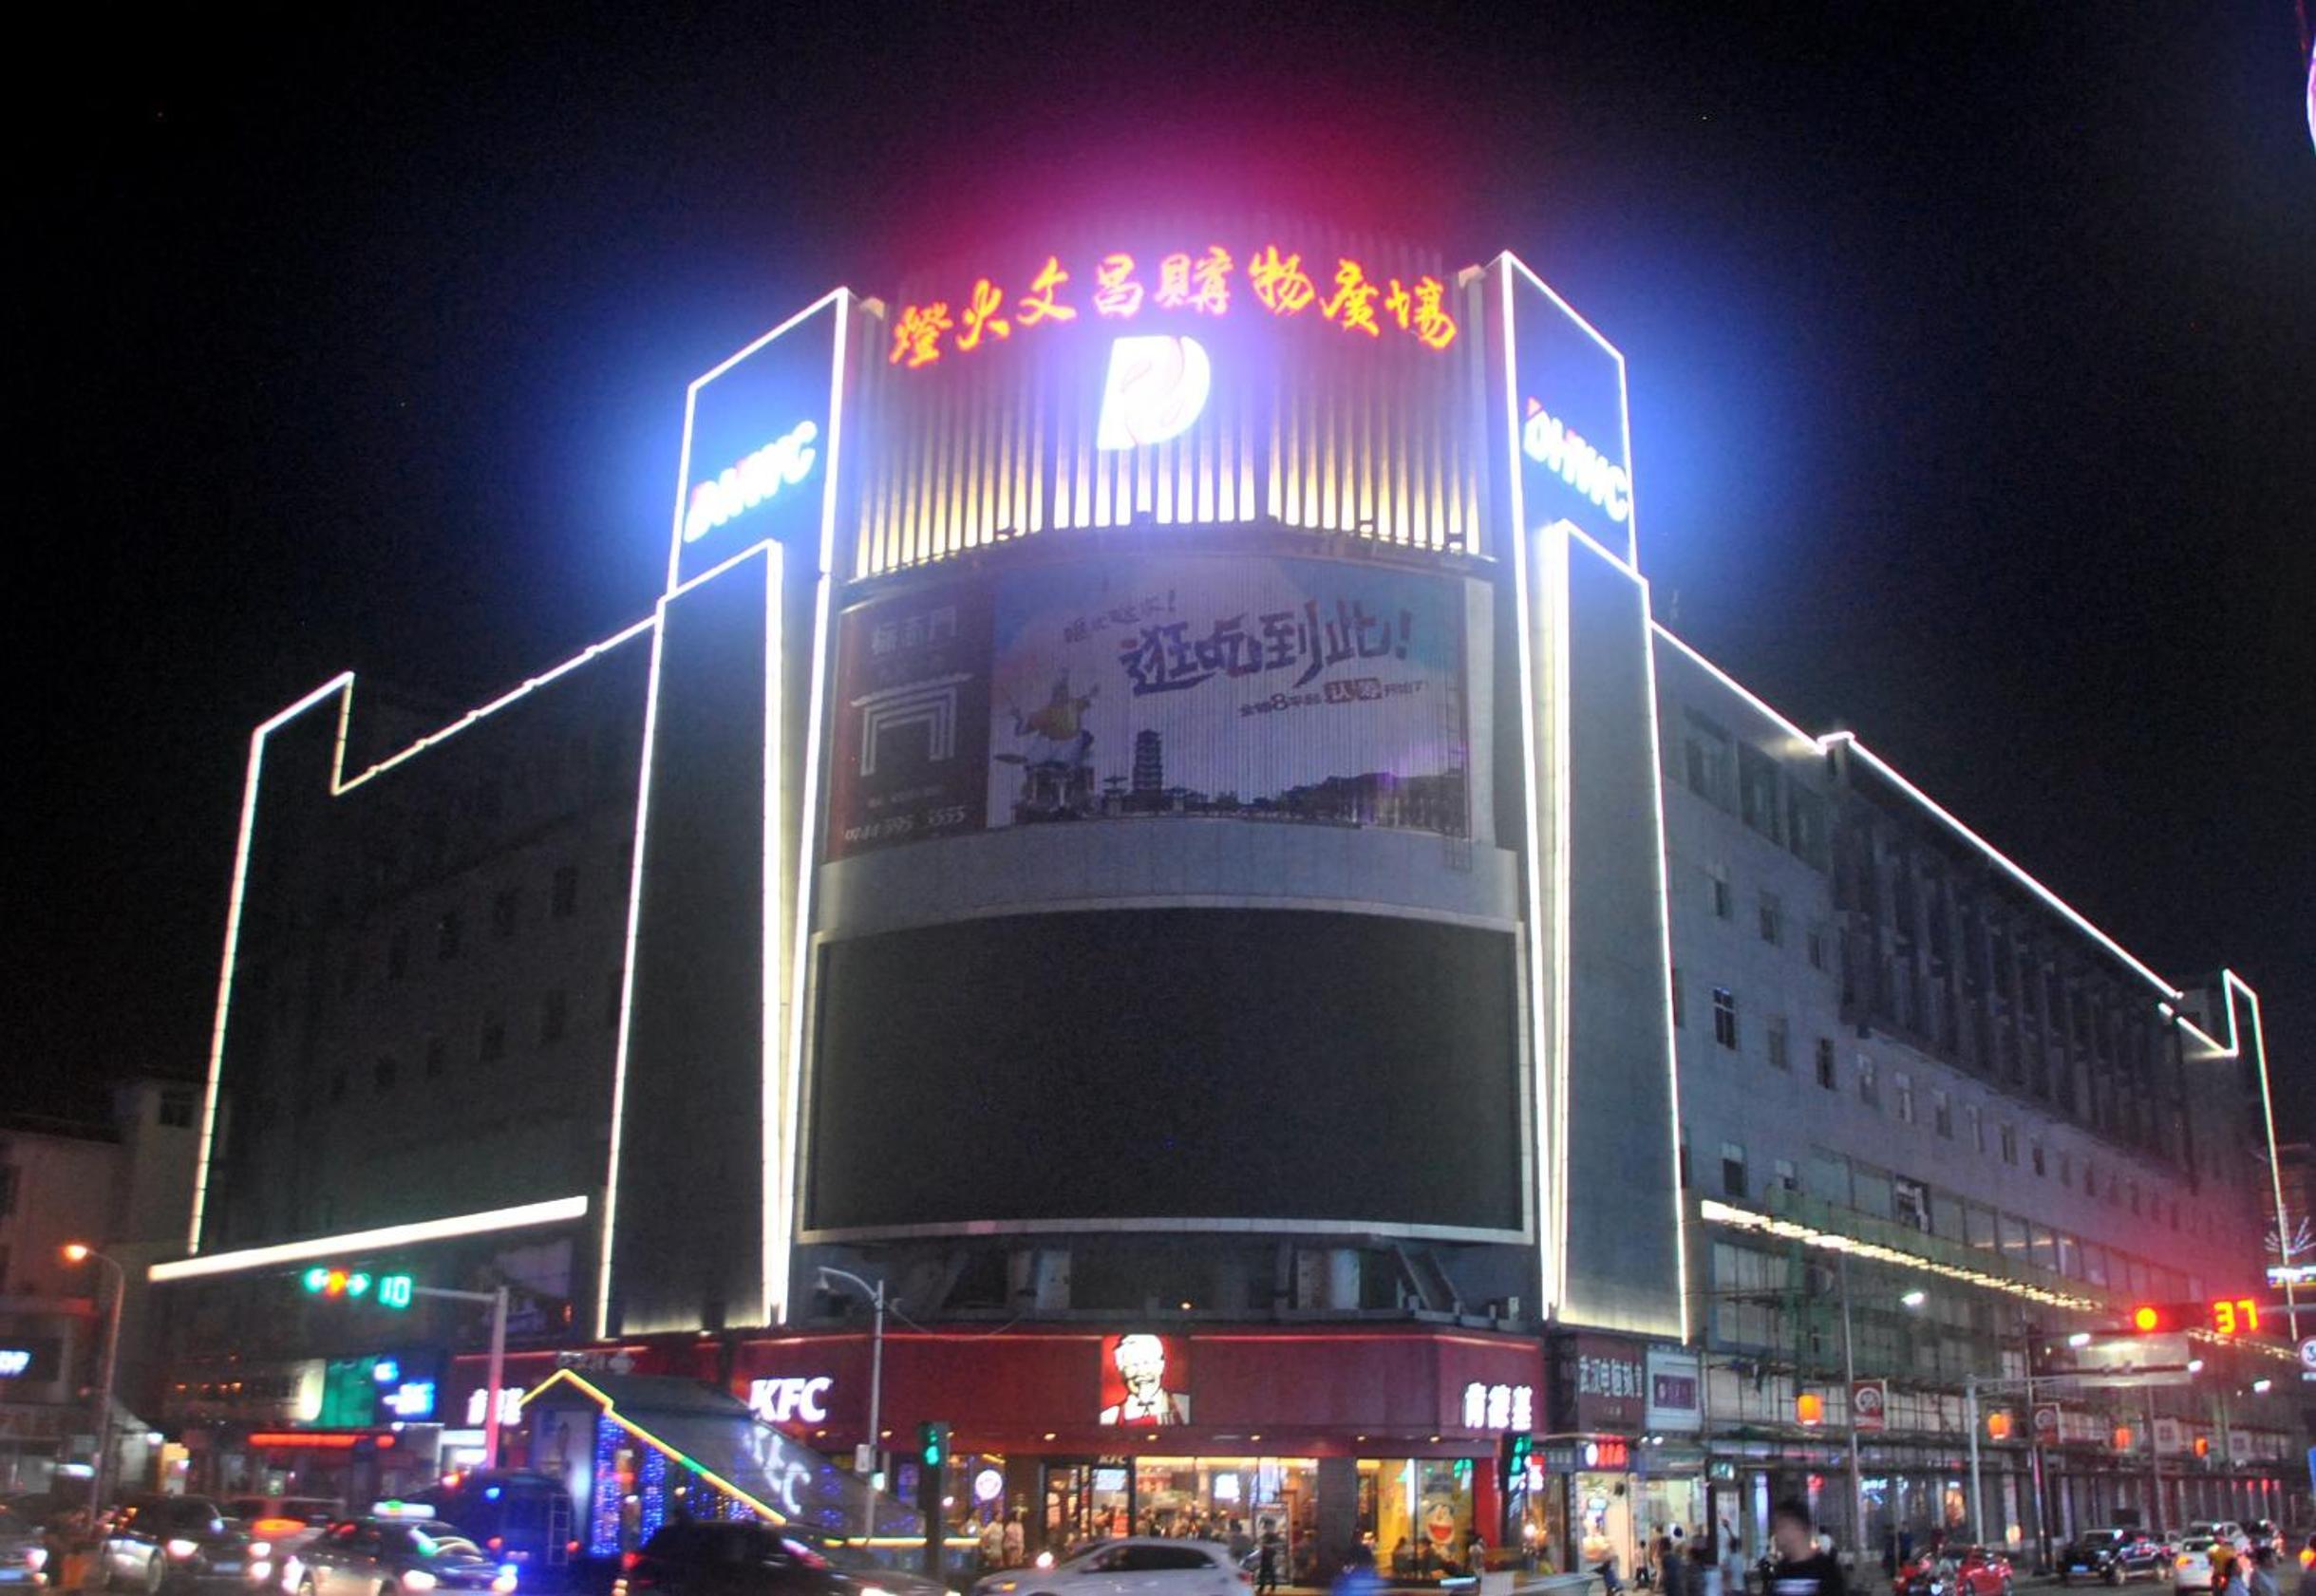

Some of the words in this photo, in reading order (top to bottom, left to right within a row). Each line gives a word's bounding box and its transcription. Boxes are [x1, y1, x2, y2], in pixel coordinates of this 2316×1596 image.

[380, 1276, 411, 1308] 10
[2213, 1298, 2259, 1334] 37
[749, 1377, 834, 1423] KFC
